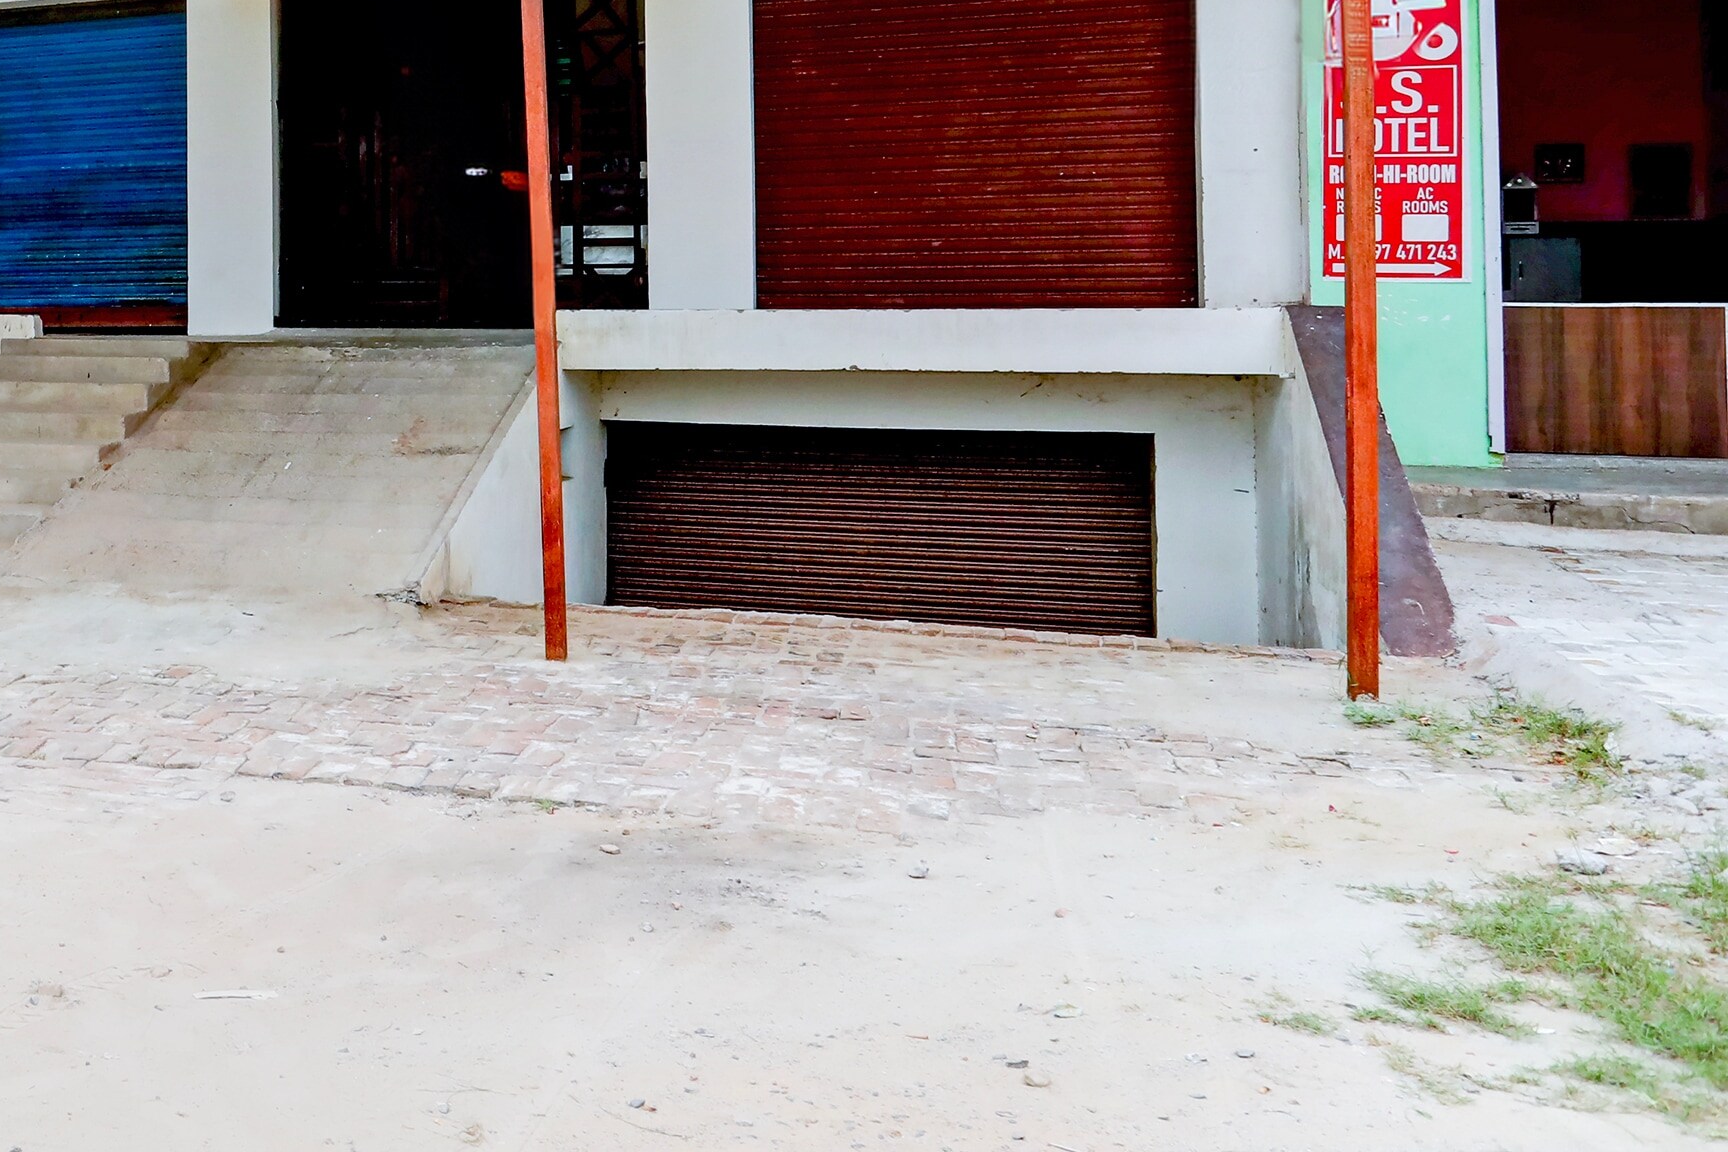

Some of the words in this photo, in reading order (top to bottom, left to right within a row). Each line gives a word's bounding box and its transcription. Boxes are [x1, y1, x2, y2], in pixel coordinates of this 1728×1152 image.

[1417, 187, 1434, 200] AC
[1402, 200, 1449, 213] ROOMS
[1396, 244, 1423, 260] 471
[1426, 244, 1457, 260] 243
